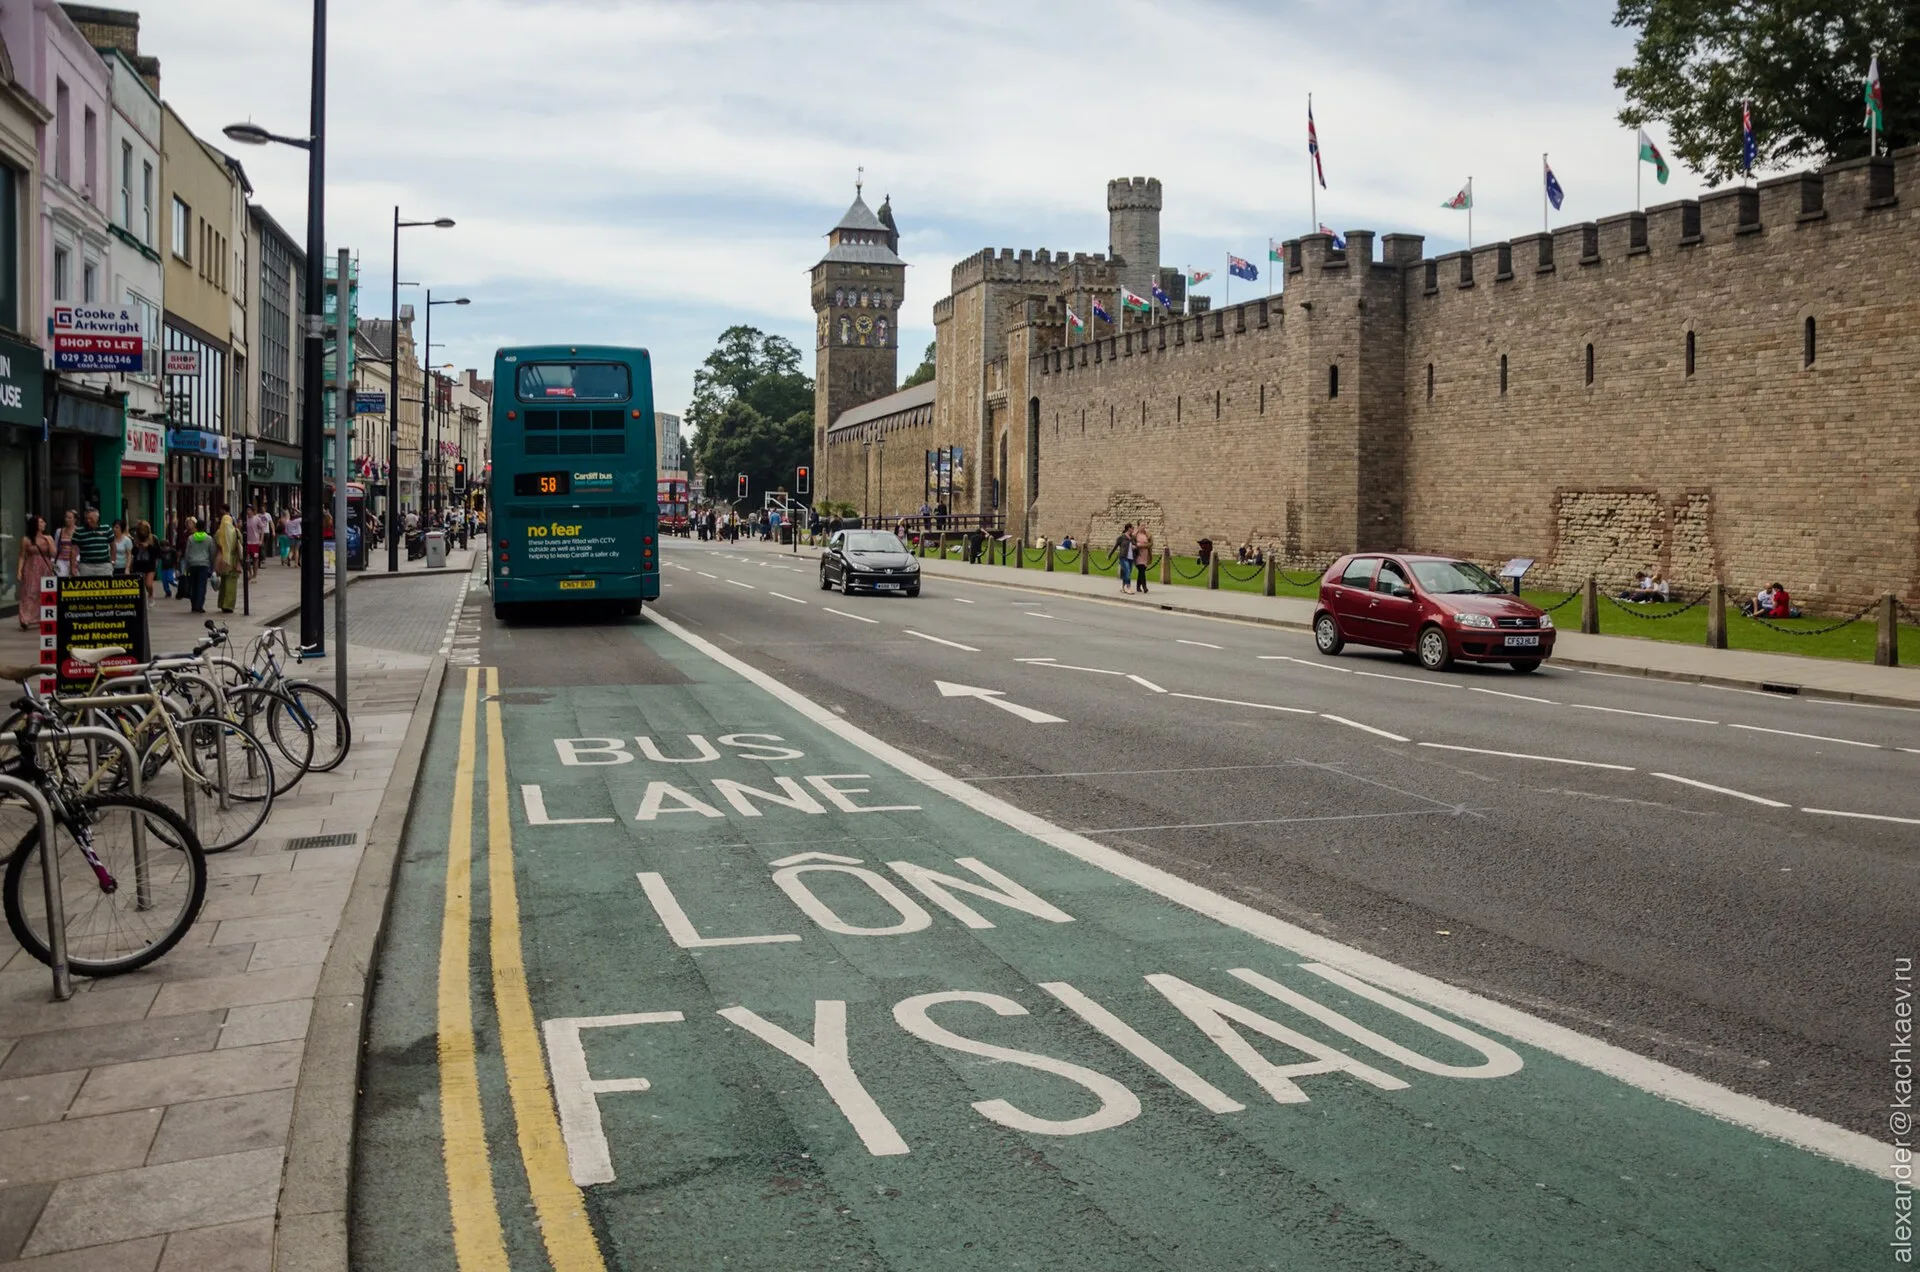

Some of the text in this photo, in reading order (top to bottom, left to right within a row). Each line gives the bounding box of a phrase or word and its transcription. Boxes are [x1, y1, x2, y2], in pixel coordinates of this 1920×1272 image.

[74, 307, 129, 320] Cooke &
[75, 320, 139, 334] Arkwright
[60, 337, 135, 350] SHOP TO LET
[61, 353, 131, 364] 029 20 346346
[170, 355, 195, 363] SHOP
[167, 363, 196, 371] RUGBY
[574, 472, 613, 480] Cardiff bus
[540, 477, 557, 492] 58
[528, 522, 582, 537] no fear
[111, 579, 139, 589] BROS
[72, 621, 125, 630] Traditional
[92, 632, 129, 640] Modern
[553, 733, 805, 767] BUS
[520, 774, 922, 825] LANE
[636, 851, 1077, 948] LÔN
[541, 961, 1526, 1187] FYSIAU
